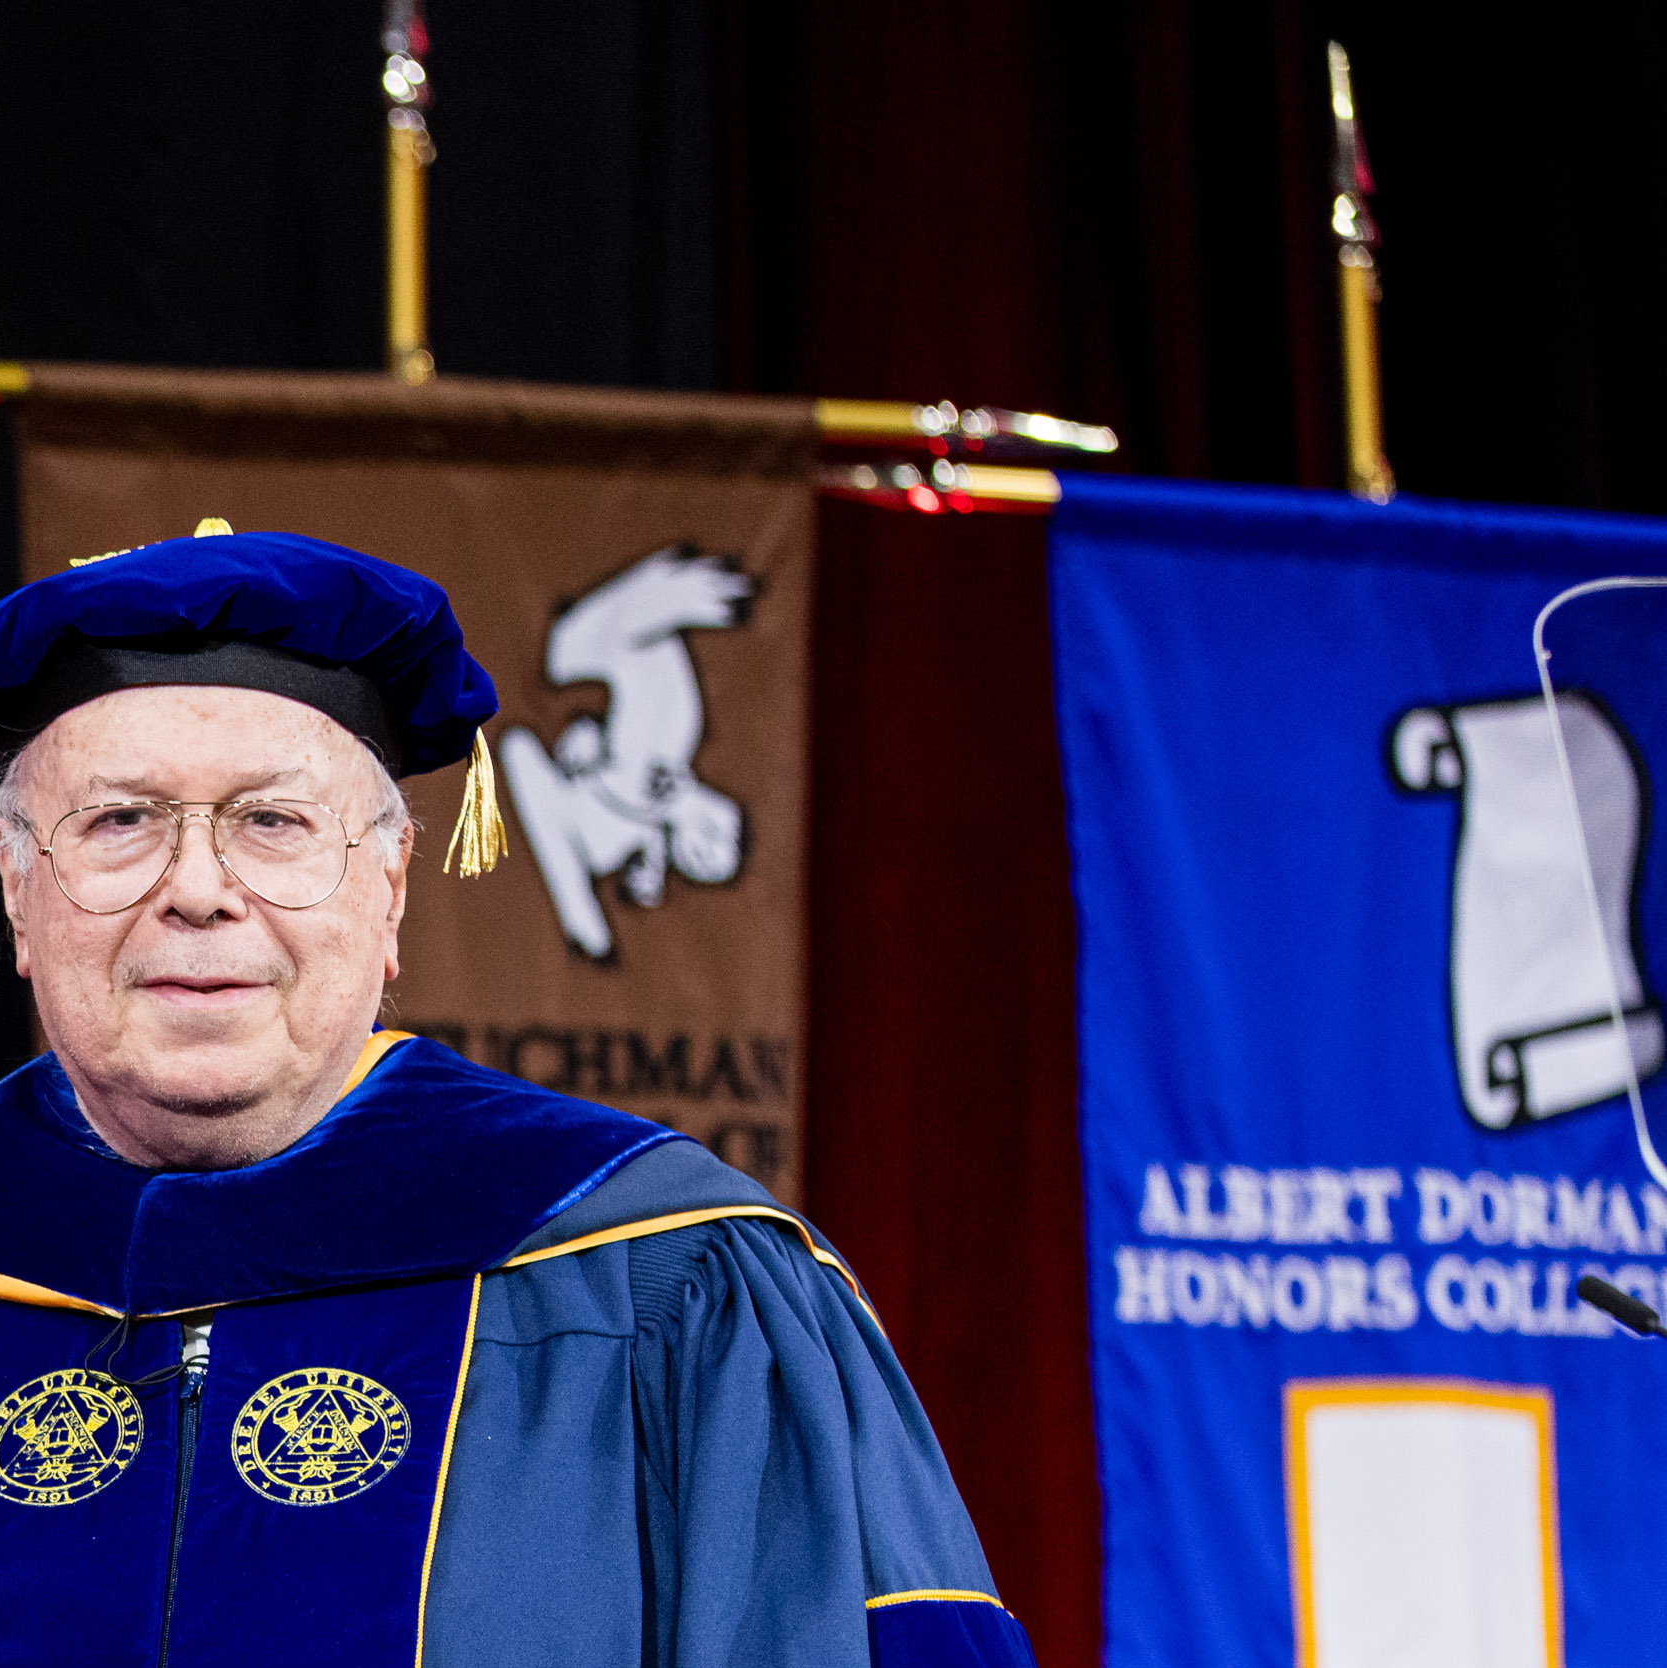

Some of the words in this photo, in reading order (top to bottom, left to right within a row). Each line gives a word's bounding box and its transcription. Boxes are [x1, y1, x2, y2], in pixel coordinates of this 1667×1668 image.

[1140, 1162, 1403, 1245] ALBERT
[1114, 1243, 1420, 1333] HONORS
[1424, 1253, 1667, 1341] COLLEG
[39, 1372, 139, 1472] UNIERSITY
[237, 1382, 291, 1474] DREXEL
[304, 1371, 407, 1472] UNIVERSITY
